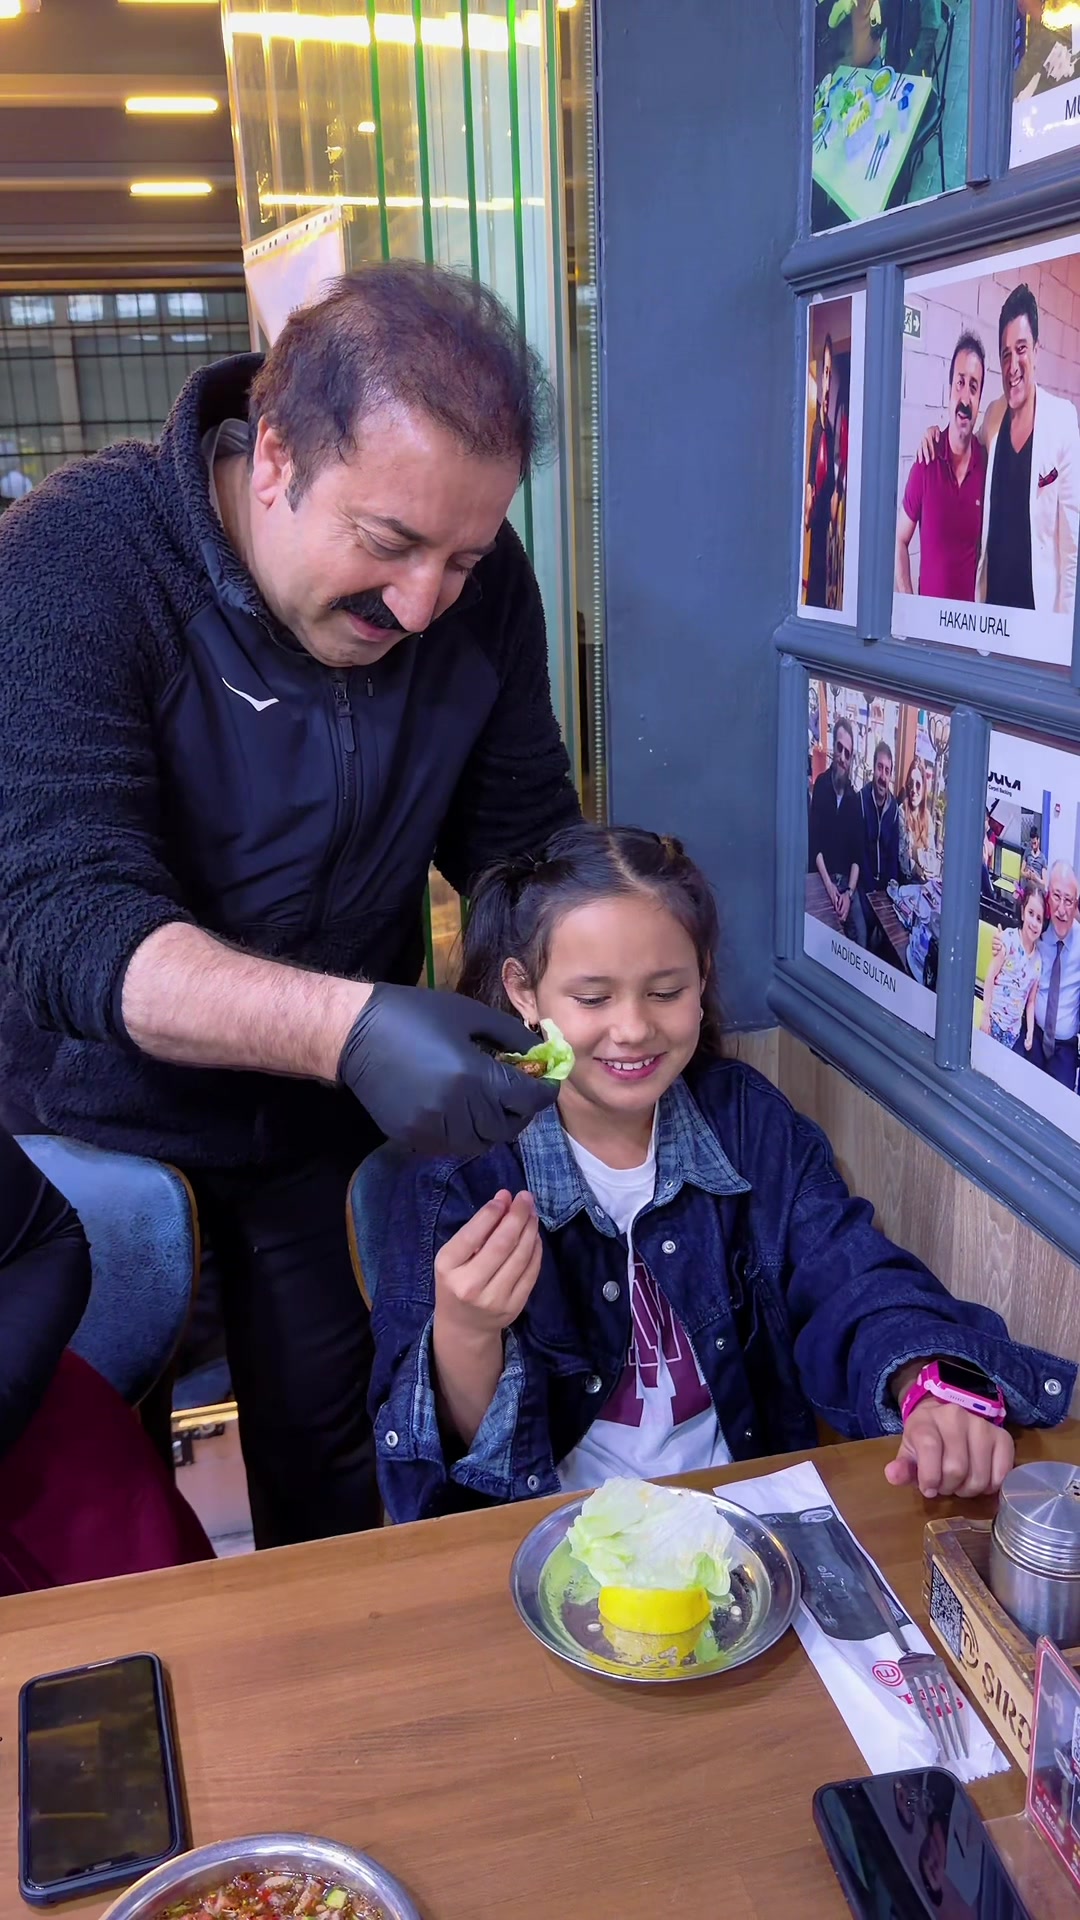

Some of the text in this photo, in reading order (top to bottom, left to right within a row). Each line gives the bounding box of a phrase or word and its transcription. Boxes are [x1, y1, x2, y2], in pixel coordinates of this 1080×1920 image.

[939, 609, 1010, 637] HAKAN URAL
[831, 939, 896, 993] NADİDE SULTAN
